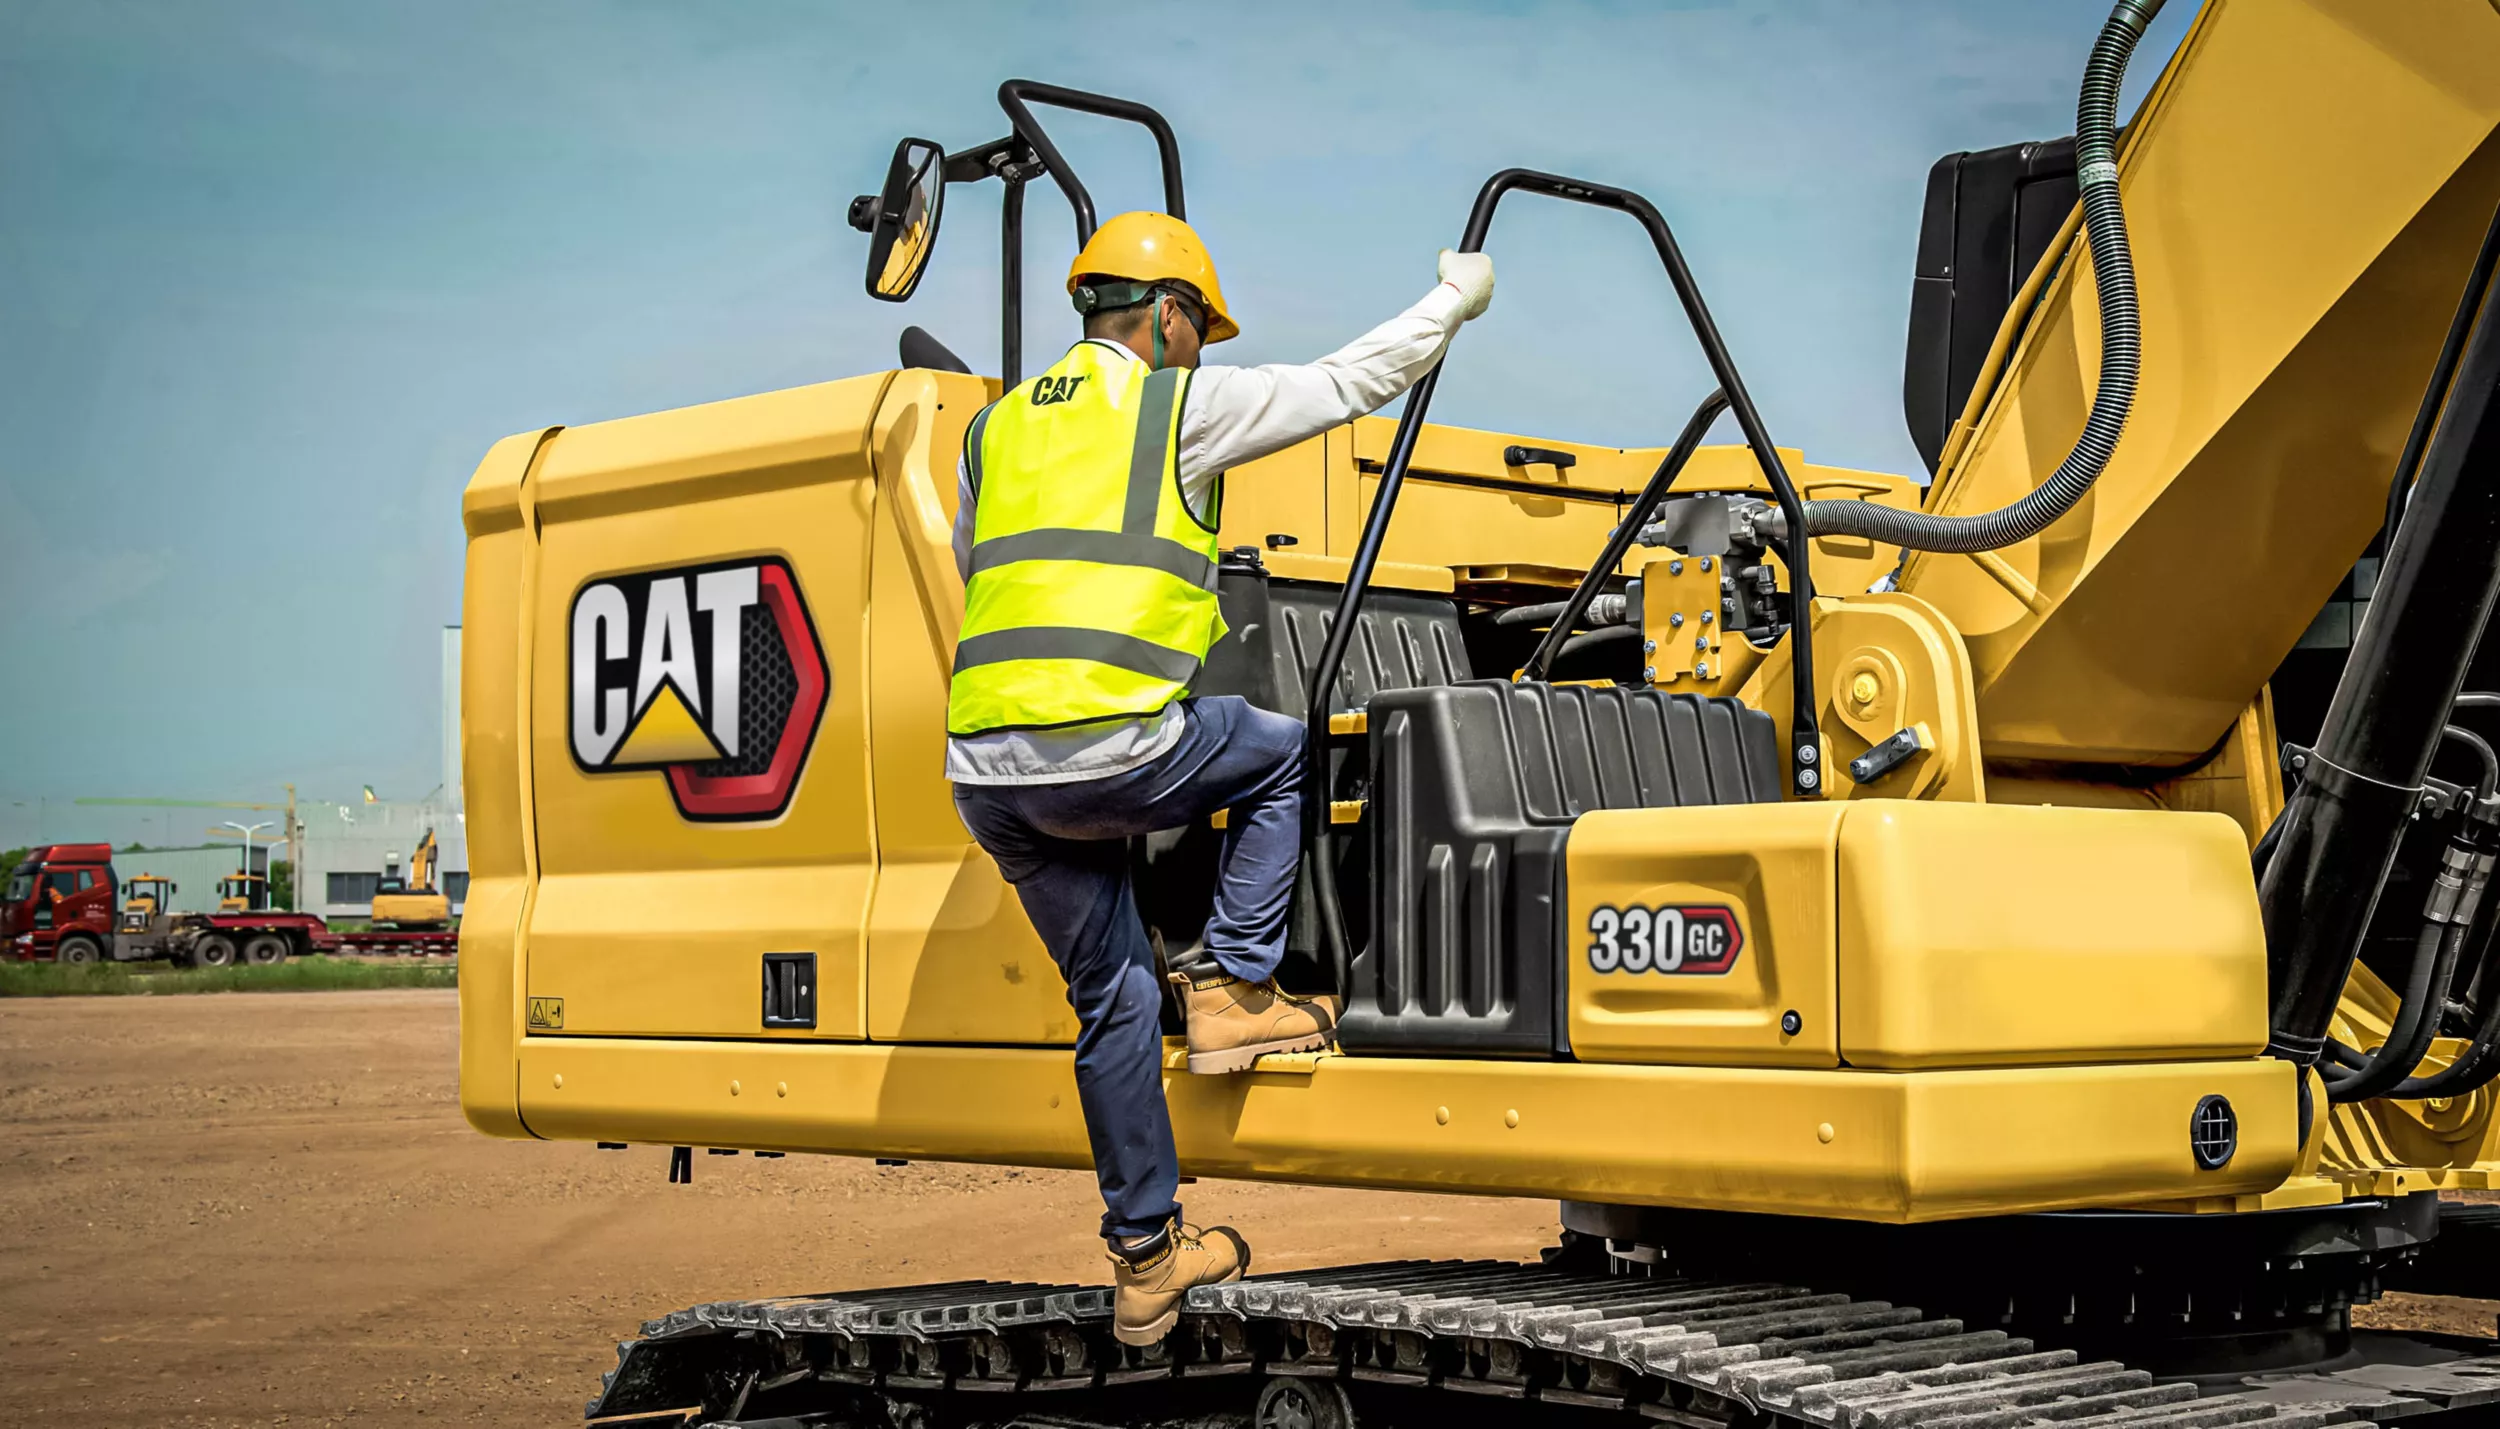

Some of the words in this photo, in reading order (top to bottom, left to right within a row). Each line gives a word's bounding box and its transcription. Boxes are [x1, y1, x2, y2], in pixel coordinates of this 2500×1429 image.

[1031, 376, 1085, 406] CAT
[573, 565, 759, 766] CAT
[1591, 908, 1685, 971] 330
[1688, 923, 1723, 957] GC
